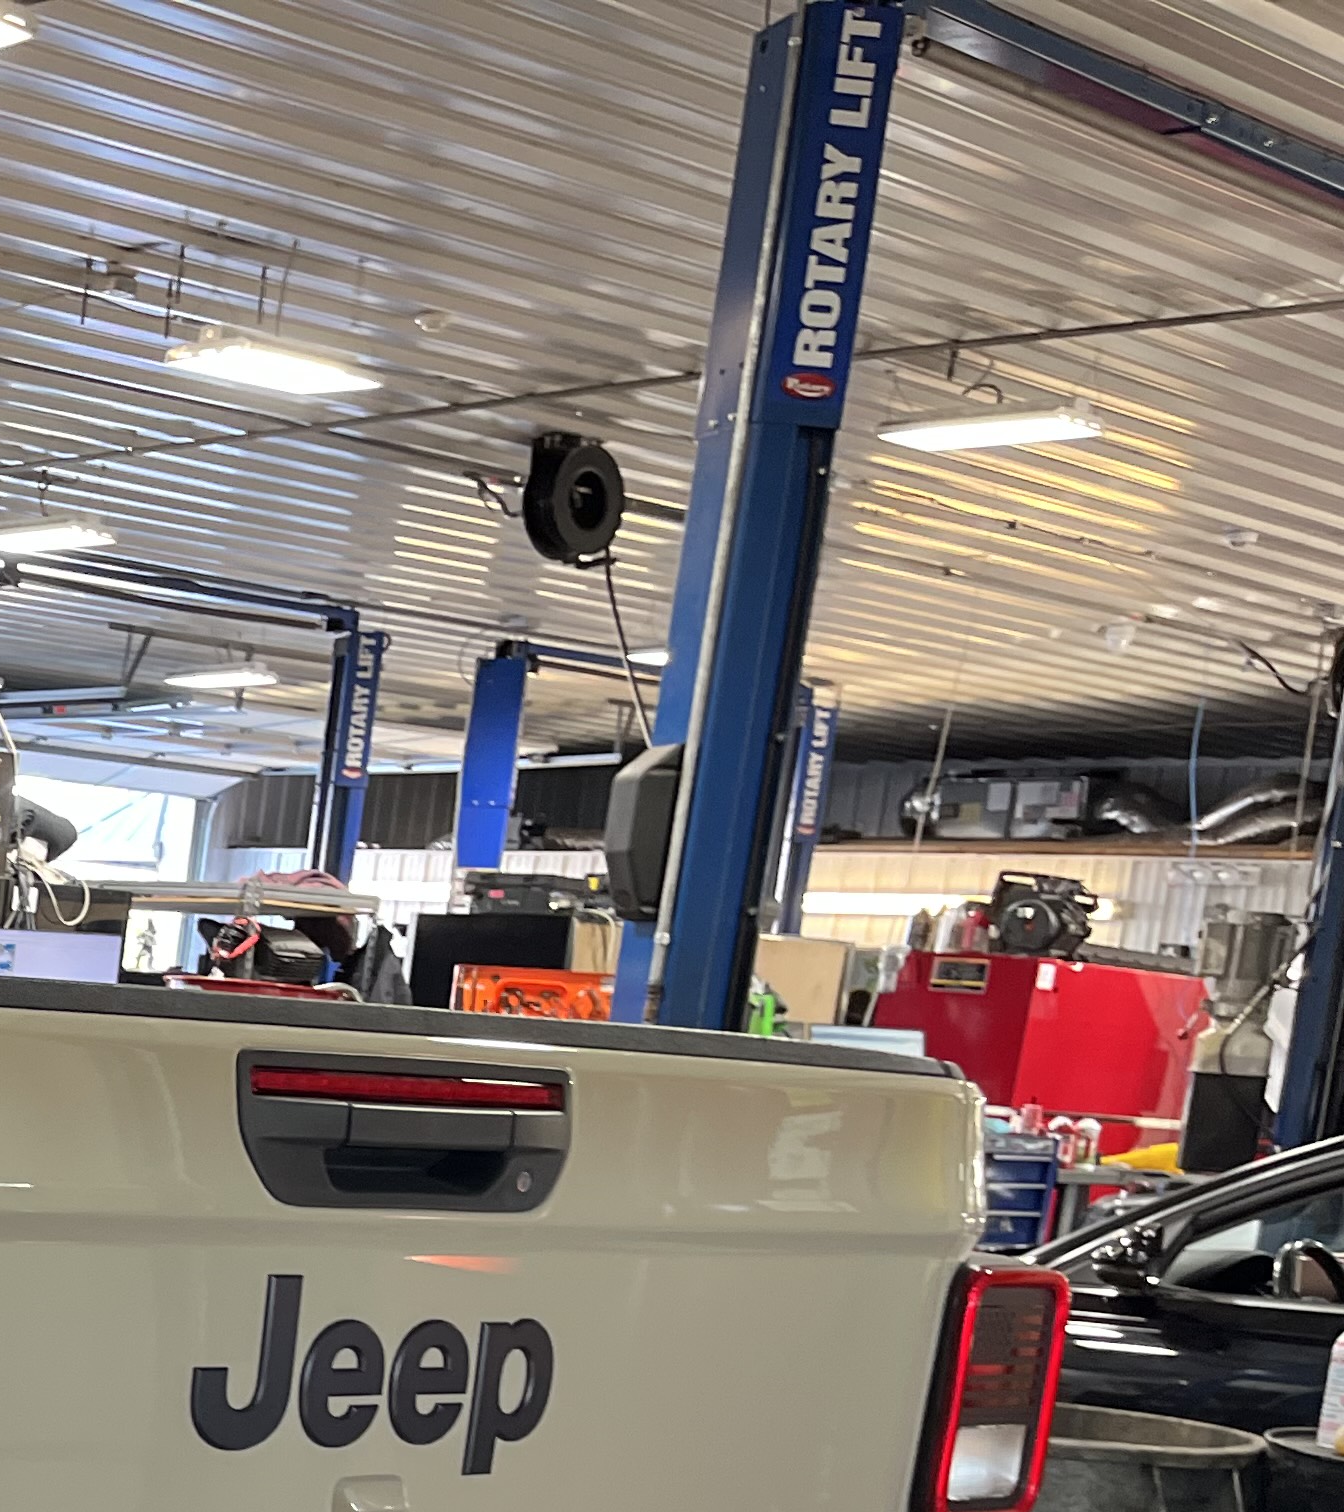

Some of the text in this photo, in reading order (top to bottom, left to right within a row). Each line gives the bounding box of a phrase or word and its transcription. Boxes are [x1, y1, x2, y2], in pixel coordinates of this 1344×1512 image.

[792, 8, 883, 369] ROTARY LIFT
[356, 635, 377, 679] LIFT
[344, 684, 371, 767] ROTARY
[810, 708, 832, 748] LIFT
[799, 752, 825, 825] ROTARY
[190, 1274, 554, 1476] Jeep
